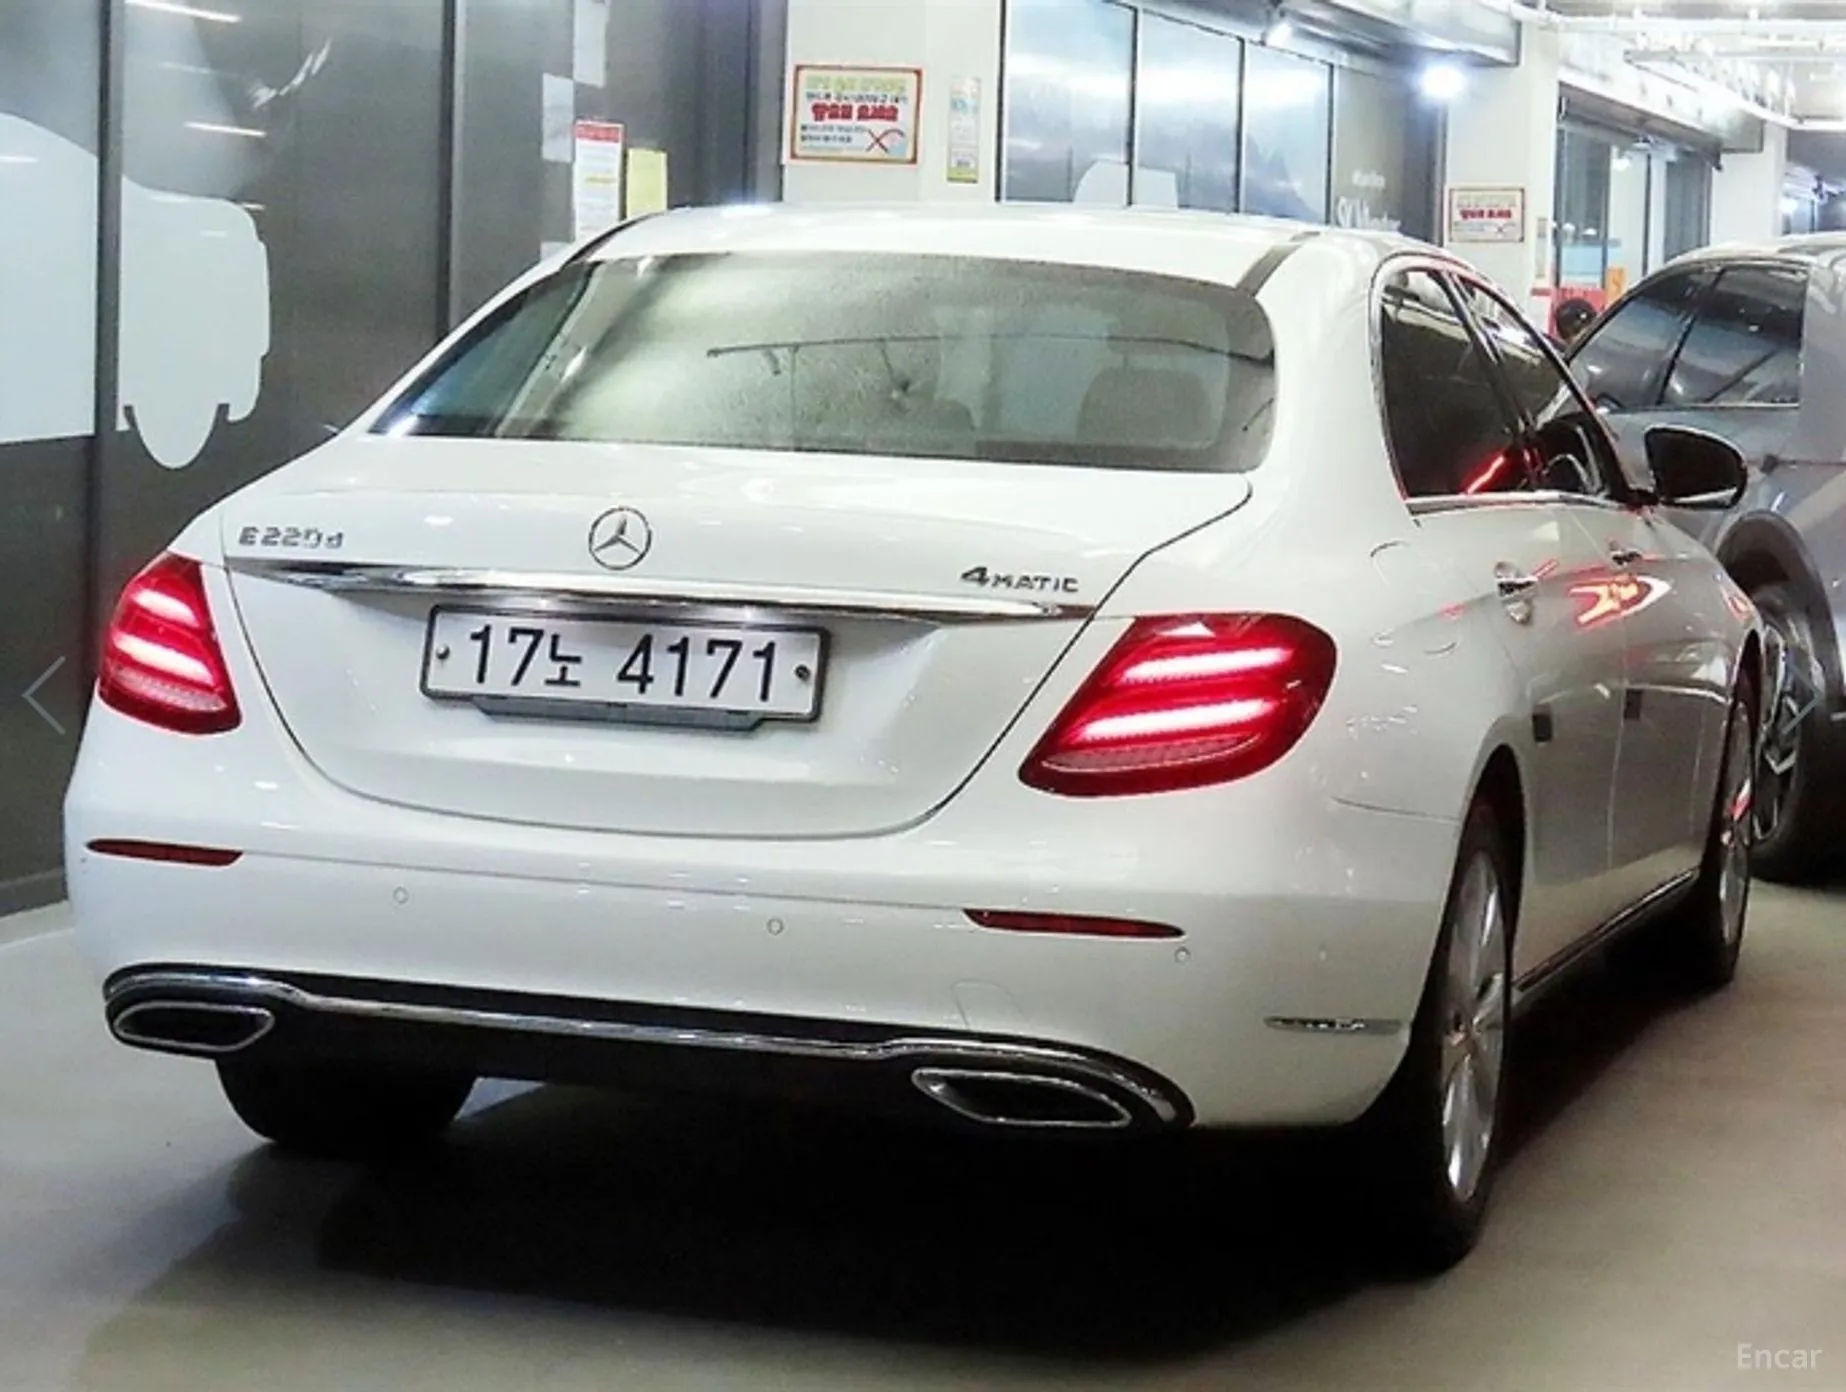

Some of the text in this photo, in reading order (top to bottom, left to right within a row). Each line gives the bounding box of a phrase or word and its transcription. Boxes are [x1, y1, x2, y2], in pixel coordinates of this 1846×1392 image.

[961, 566, 1079, 592] 4MATIC
[469, 624, 776, 702] 17노 4171
